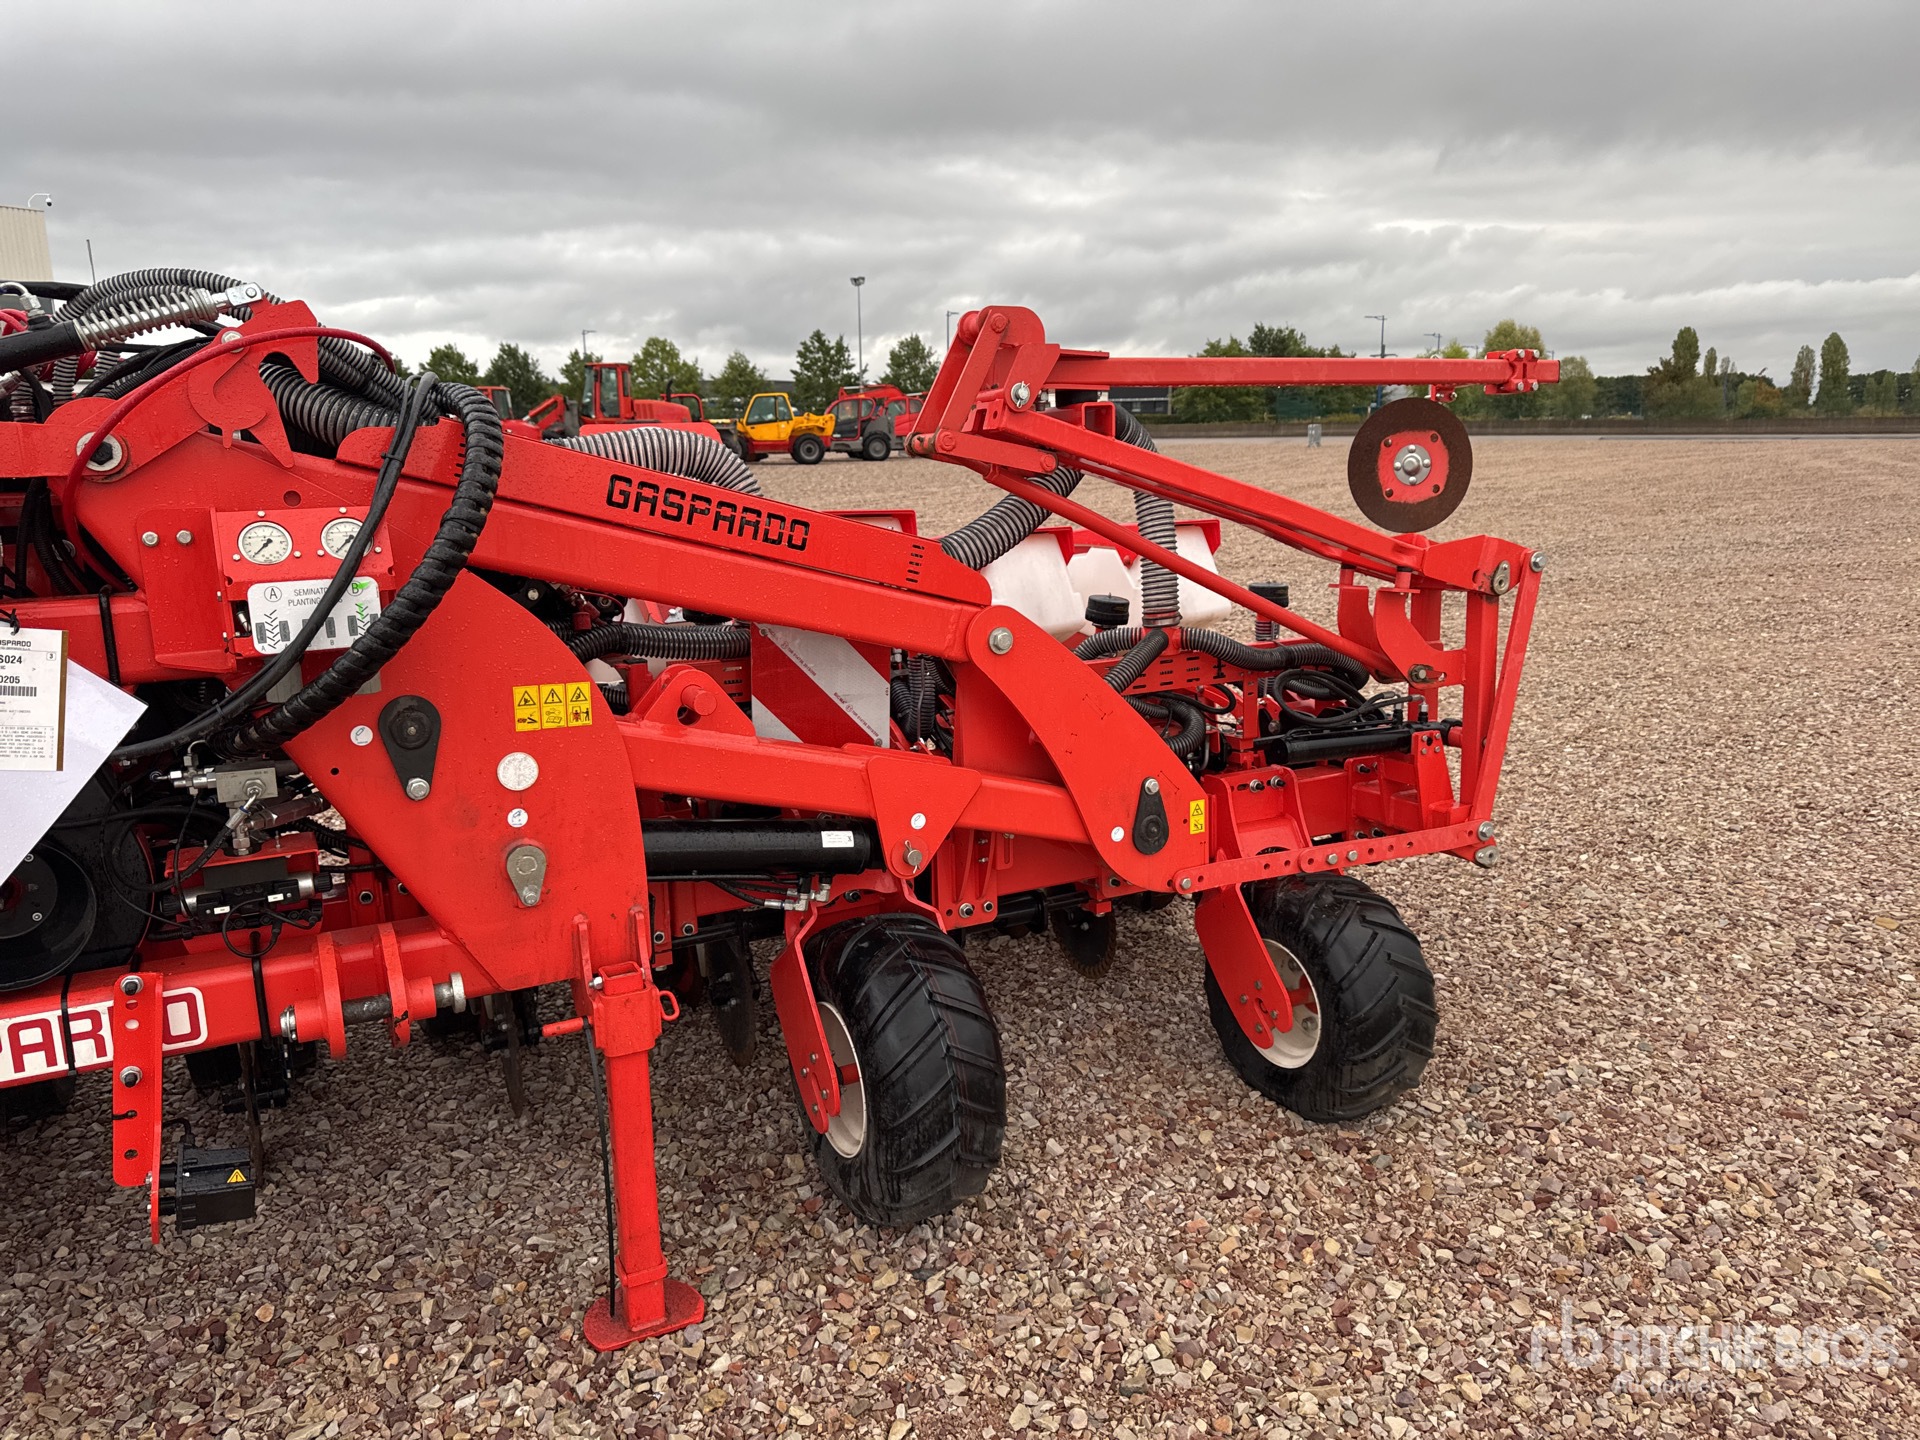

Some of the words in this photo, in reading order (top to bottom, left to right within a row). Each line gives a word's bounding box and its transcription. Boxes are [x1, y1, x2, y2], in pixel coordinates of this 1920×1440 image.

[606, 473, 811, 552] GASPARDO
[269, 587, 278, 600] A
[351, 582, 360, 595] B
